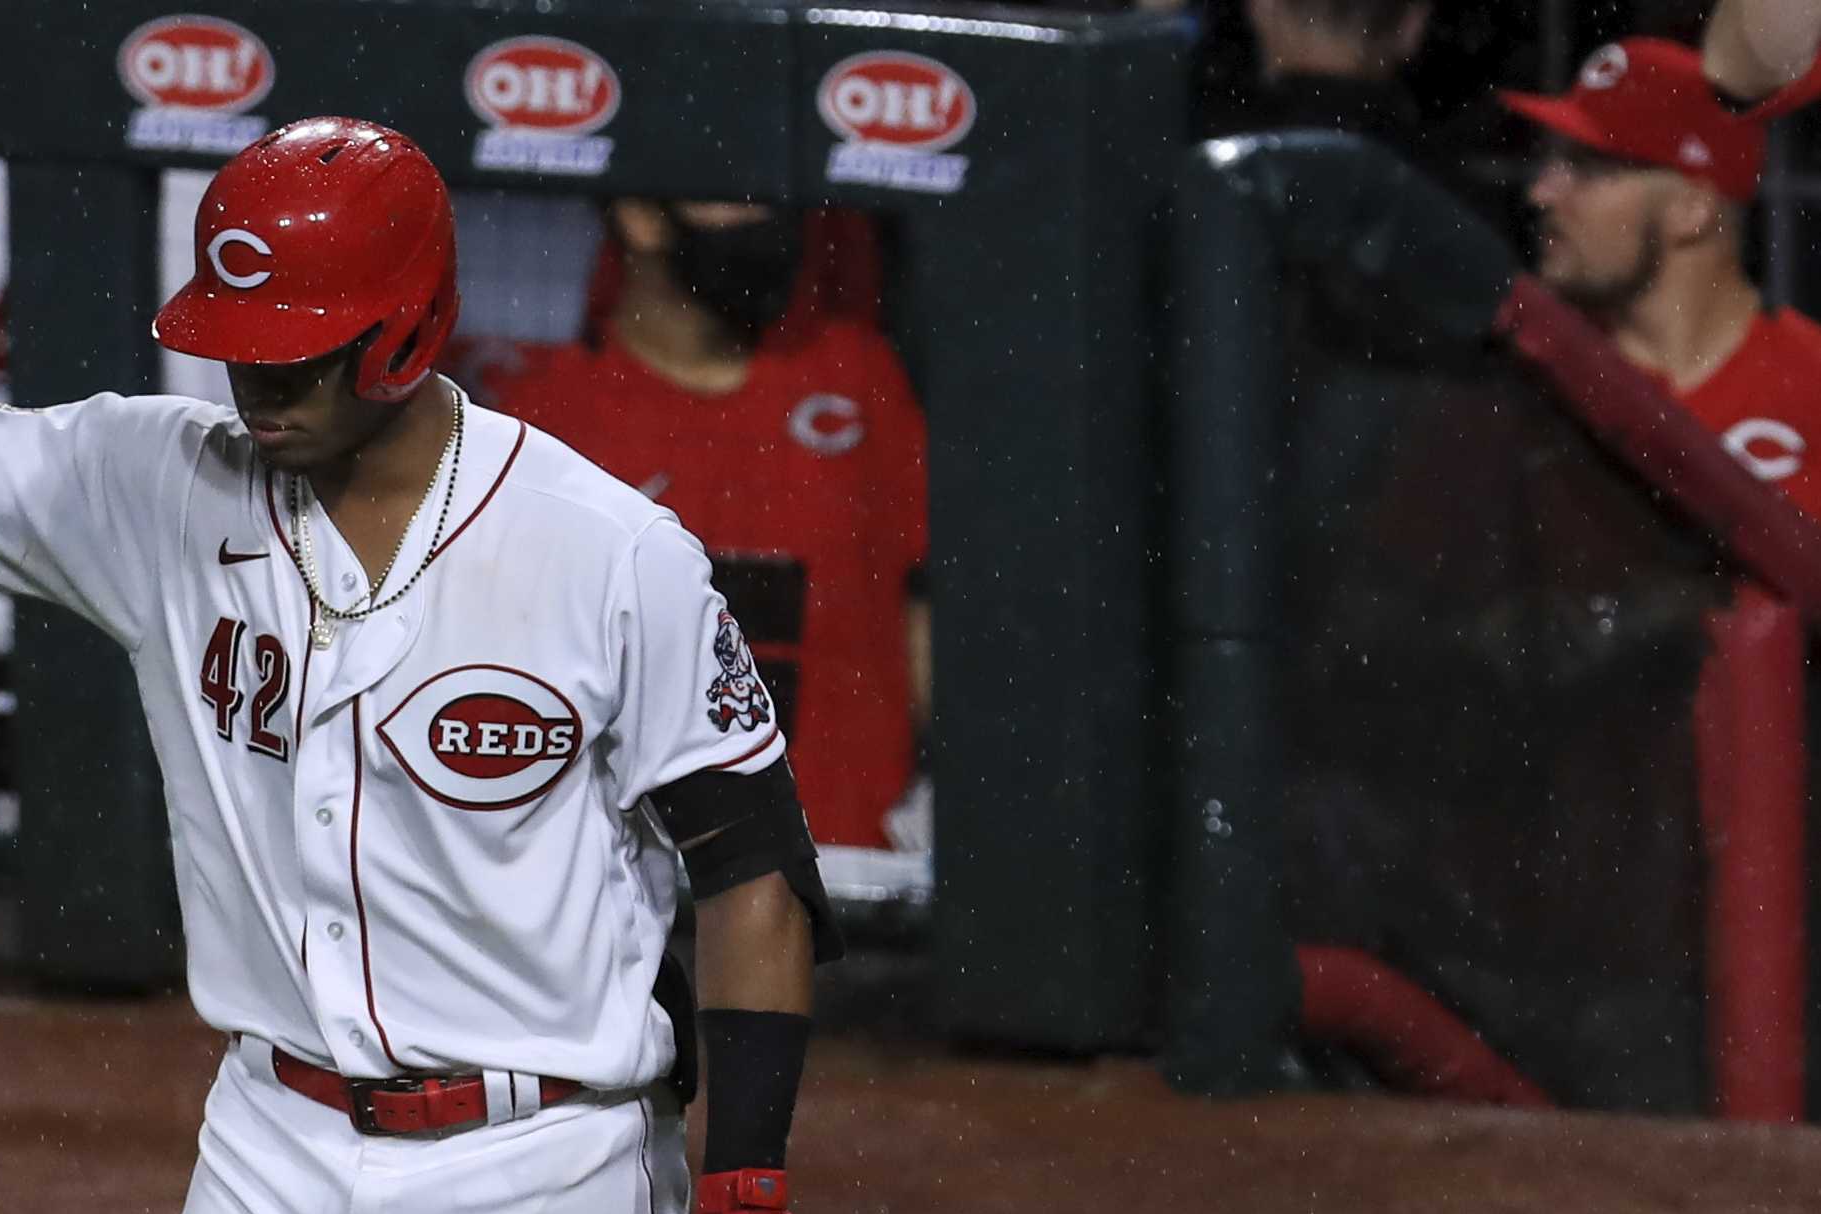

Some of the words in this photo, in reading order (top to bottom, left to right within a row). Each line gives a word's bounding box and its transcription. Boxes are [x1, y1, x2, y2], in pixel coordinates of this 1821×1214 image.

[206, 228, 272, 289] C
[788, 393, 865, 456] C
[1721, 418, 1806, 481] C
[200, 616, 292, 763] 42
[436, 718, 575, 758] REDS
